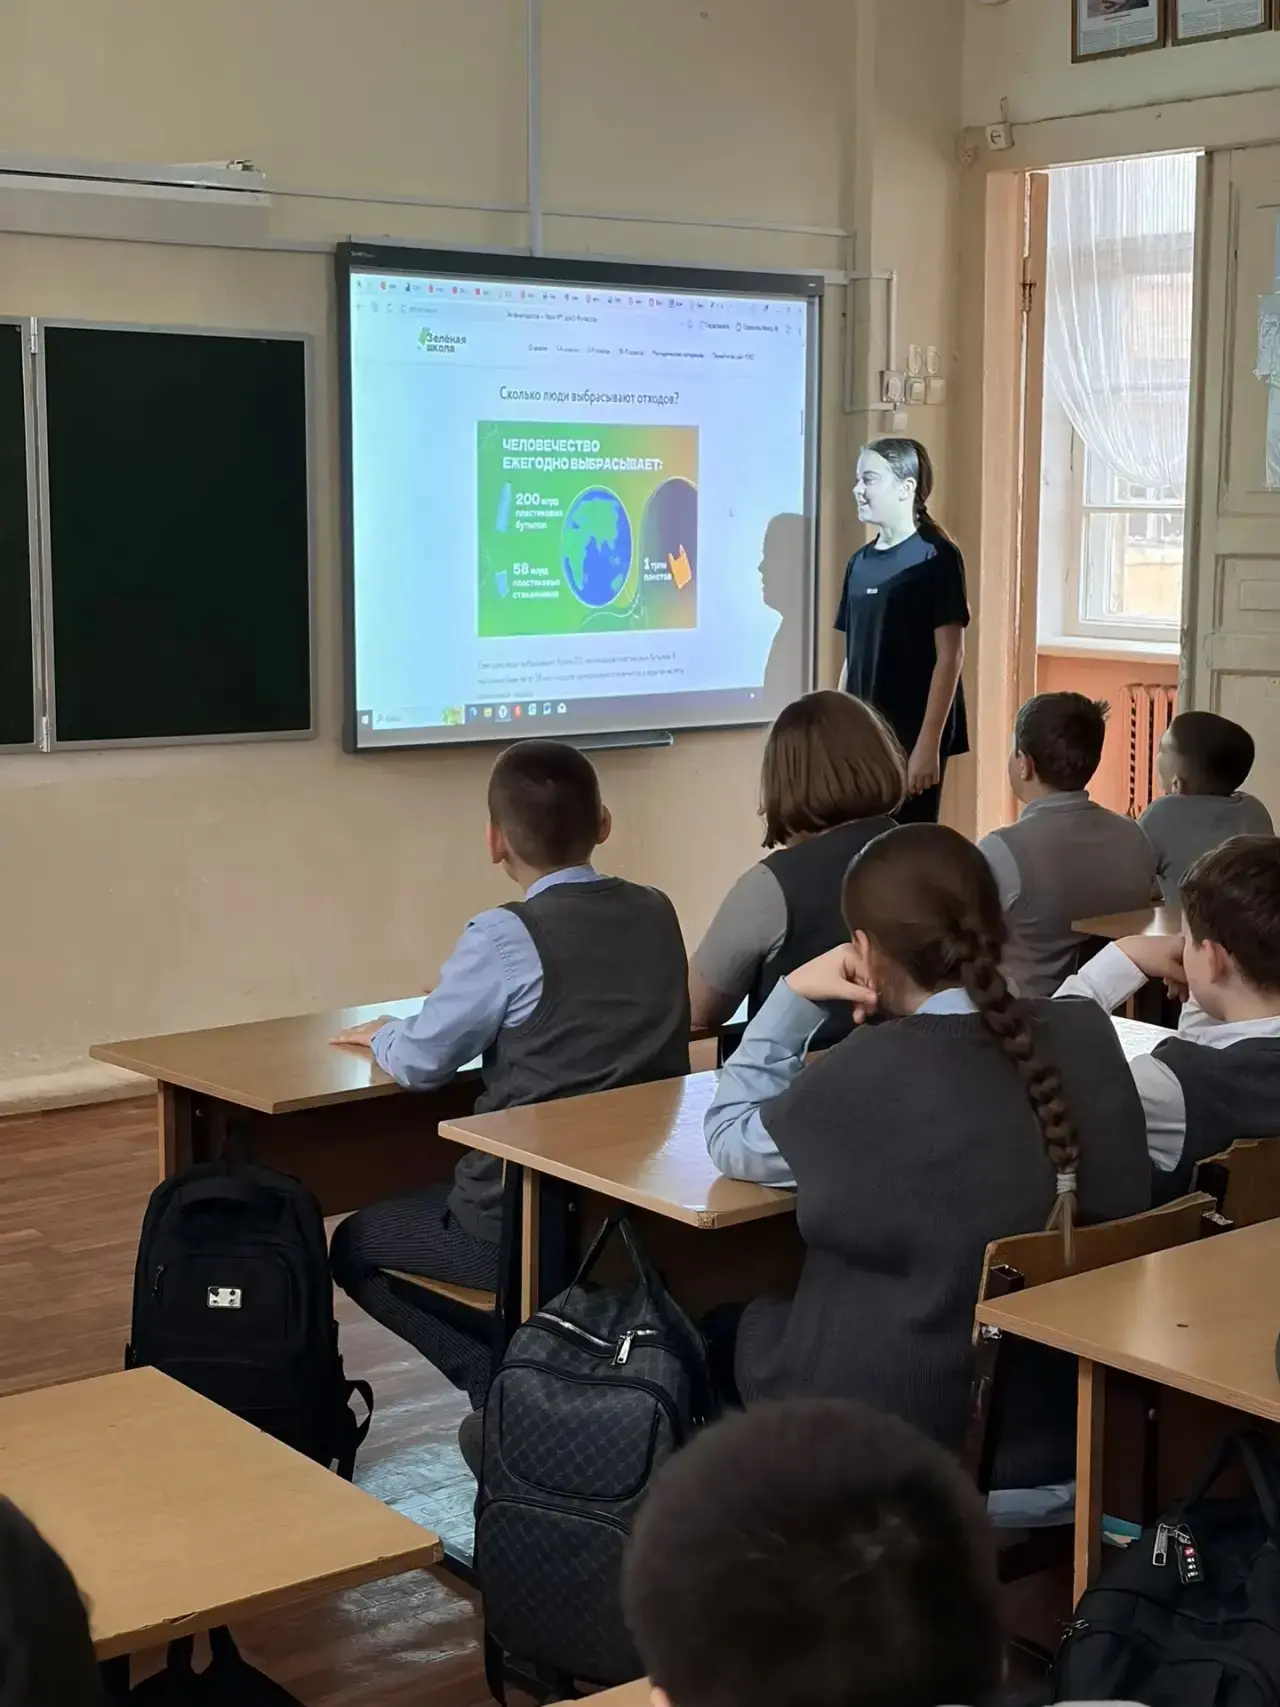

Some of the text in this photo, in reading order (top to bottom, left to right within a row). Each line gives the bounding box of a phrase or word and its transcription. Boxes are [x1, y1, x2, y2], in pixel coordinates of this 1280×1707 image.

[426, 332, 467, 344] Зелёная
[499, 386, 680, 405] Сколько люди выбрасывают отходов?
[502, 438, 600, 452] ЧЕЛОВЕЧЕСТВО
[502, 456, 664, 471] ЕЖЕГОДНО ВЫБРАСЫВАЕТ:
[515, 492, 540, 505] 200
[512, 562, 530, 575] 58
[643, 556, 650, 570] 1
